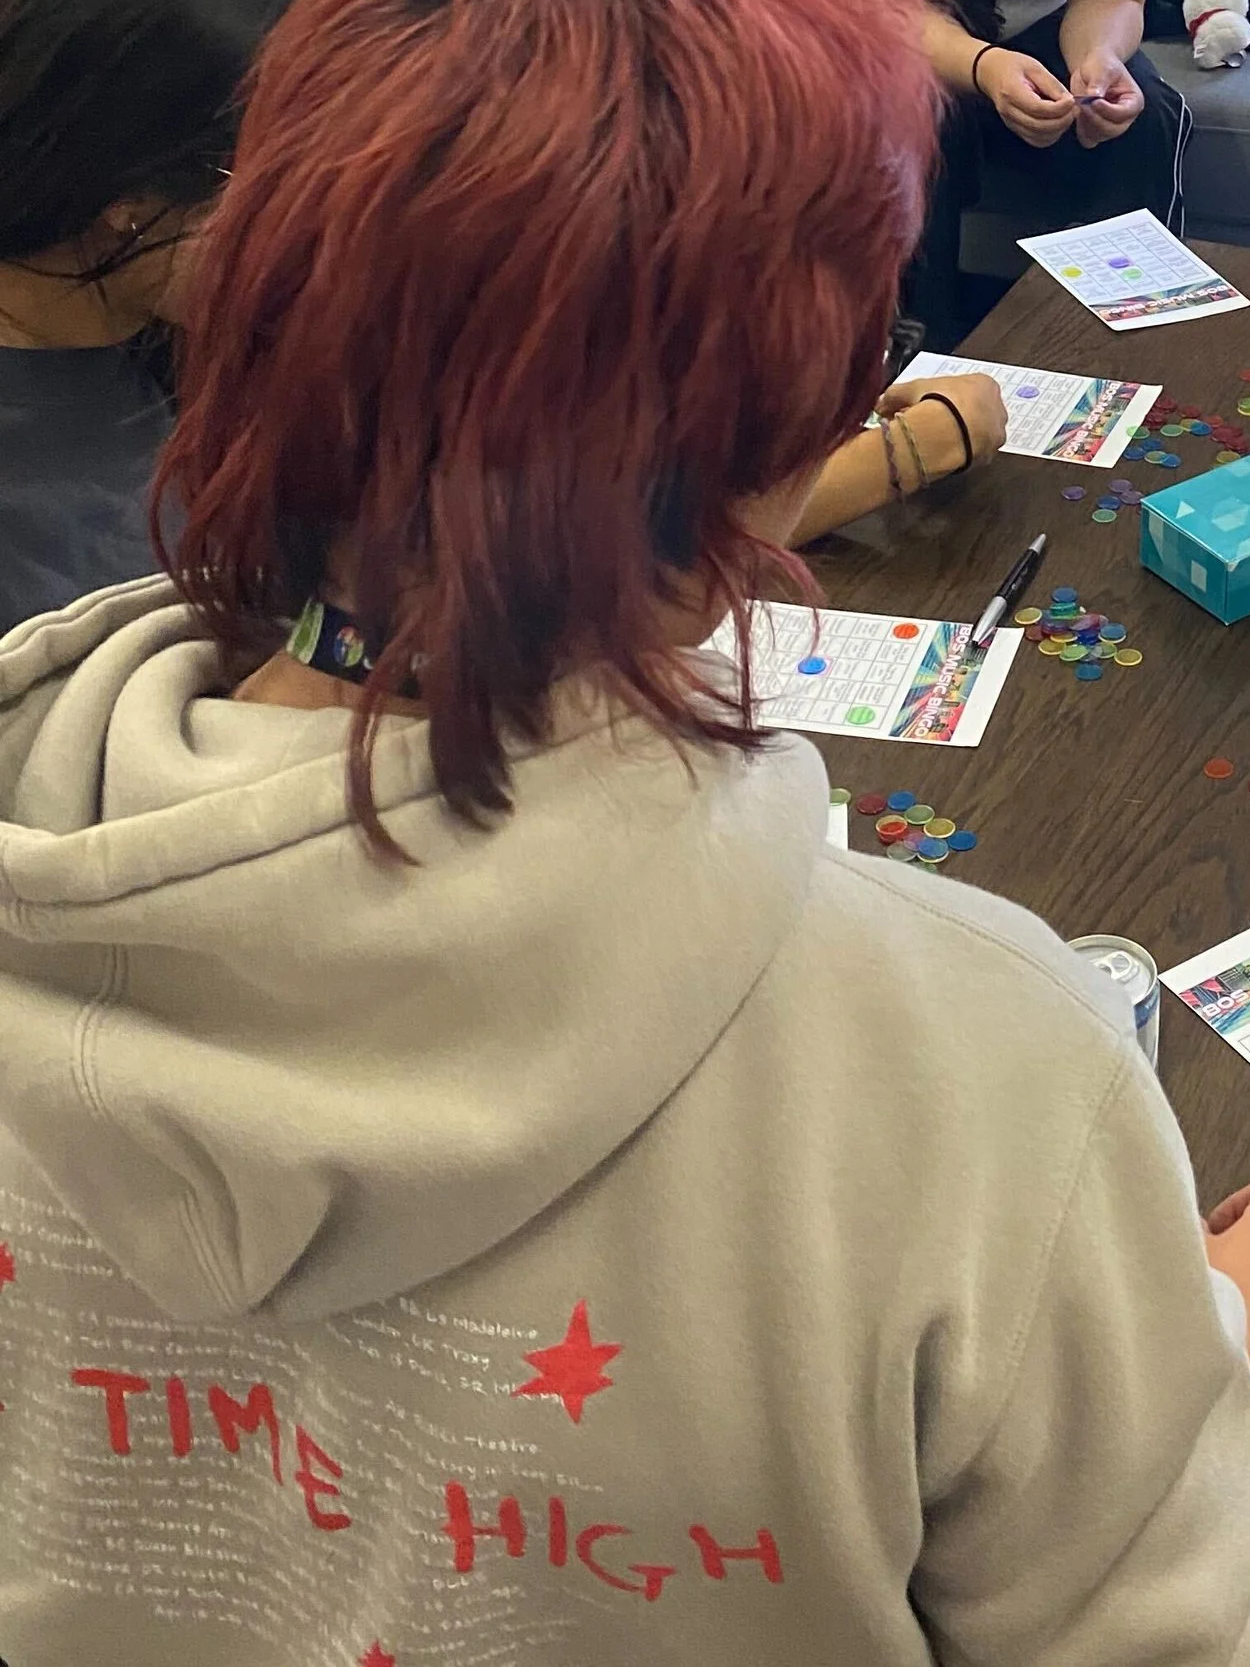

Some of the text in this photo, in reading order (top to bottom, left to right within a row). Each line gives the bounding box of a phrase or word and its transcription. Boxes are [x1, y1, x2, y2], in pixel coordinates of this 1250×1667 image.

[913, 626, 972, 737] 80S MUSIC BINGO
[1199, 987, 1250, 1018] 80S
[70, 1367, 784, 1601] TIME HIGH
